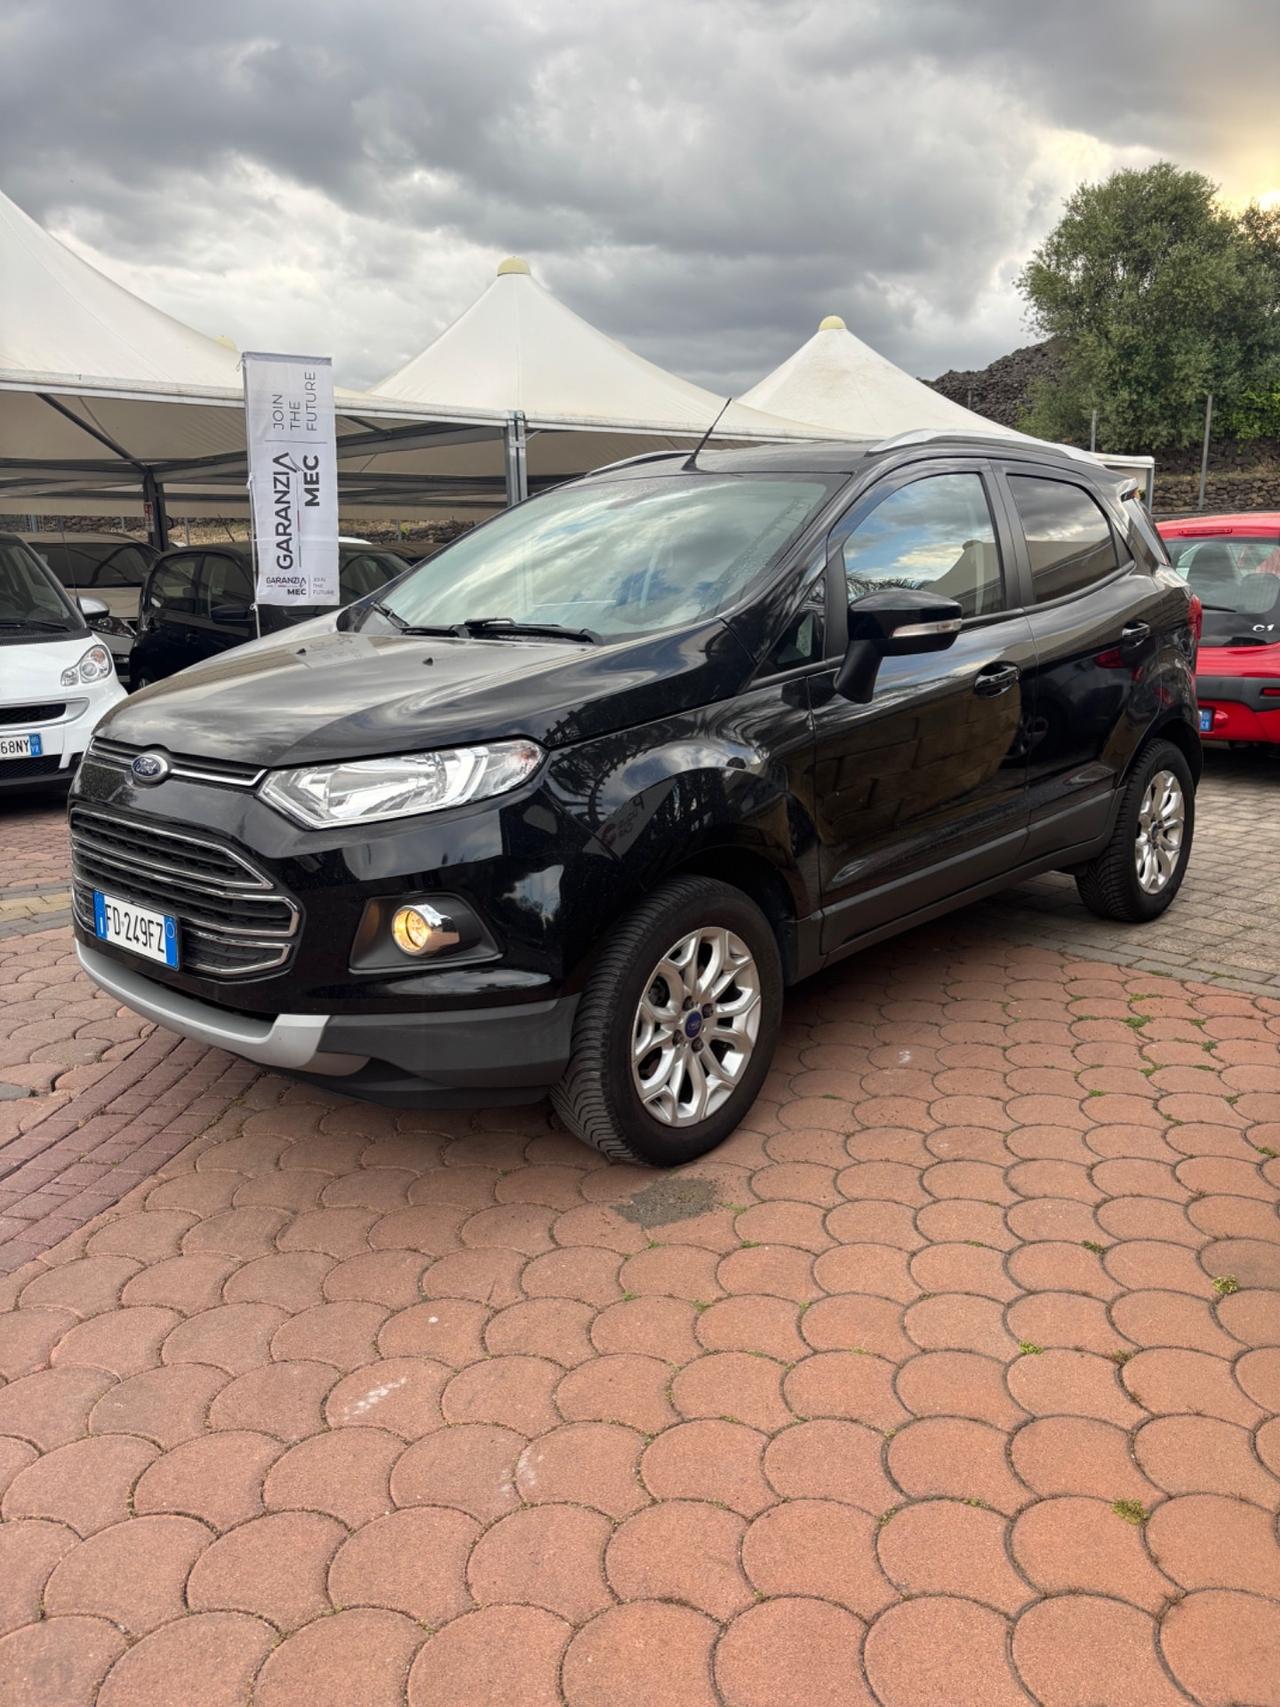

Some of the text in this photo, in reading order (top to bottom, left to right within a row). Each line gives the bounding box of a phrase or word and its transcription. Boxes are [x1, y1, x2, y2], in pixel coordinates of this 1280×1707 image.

[272, 394, 284, 430] JOIN
[289, 400, 301, 430] THE
[304, 371, 317, 431] FUTURE
[303, 455, 320, 506] MEC
[272, 452, 297, 570] GARANZIA
[1252, 624, 1275, 632] C1
